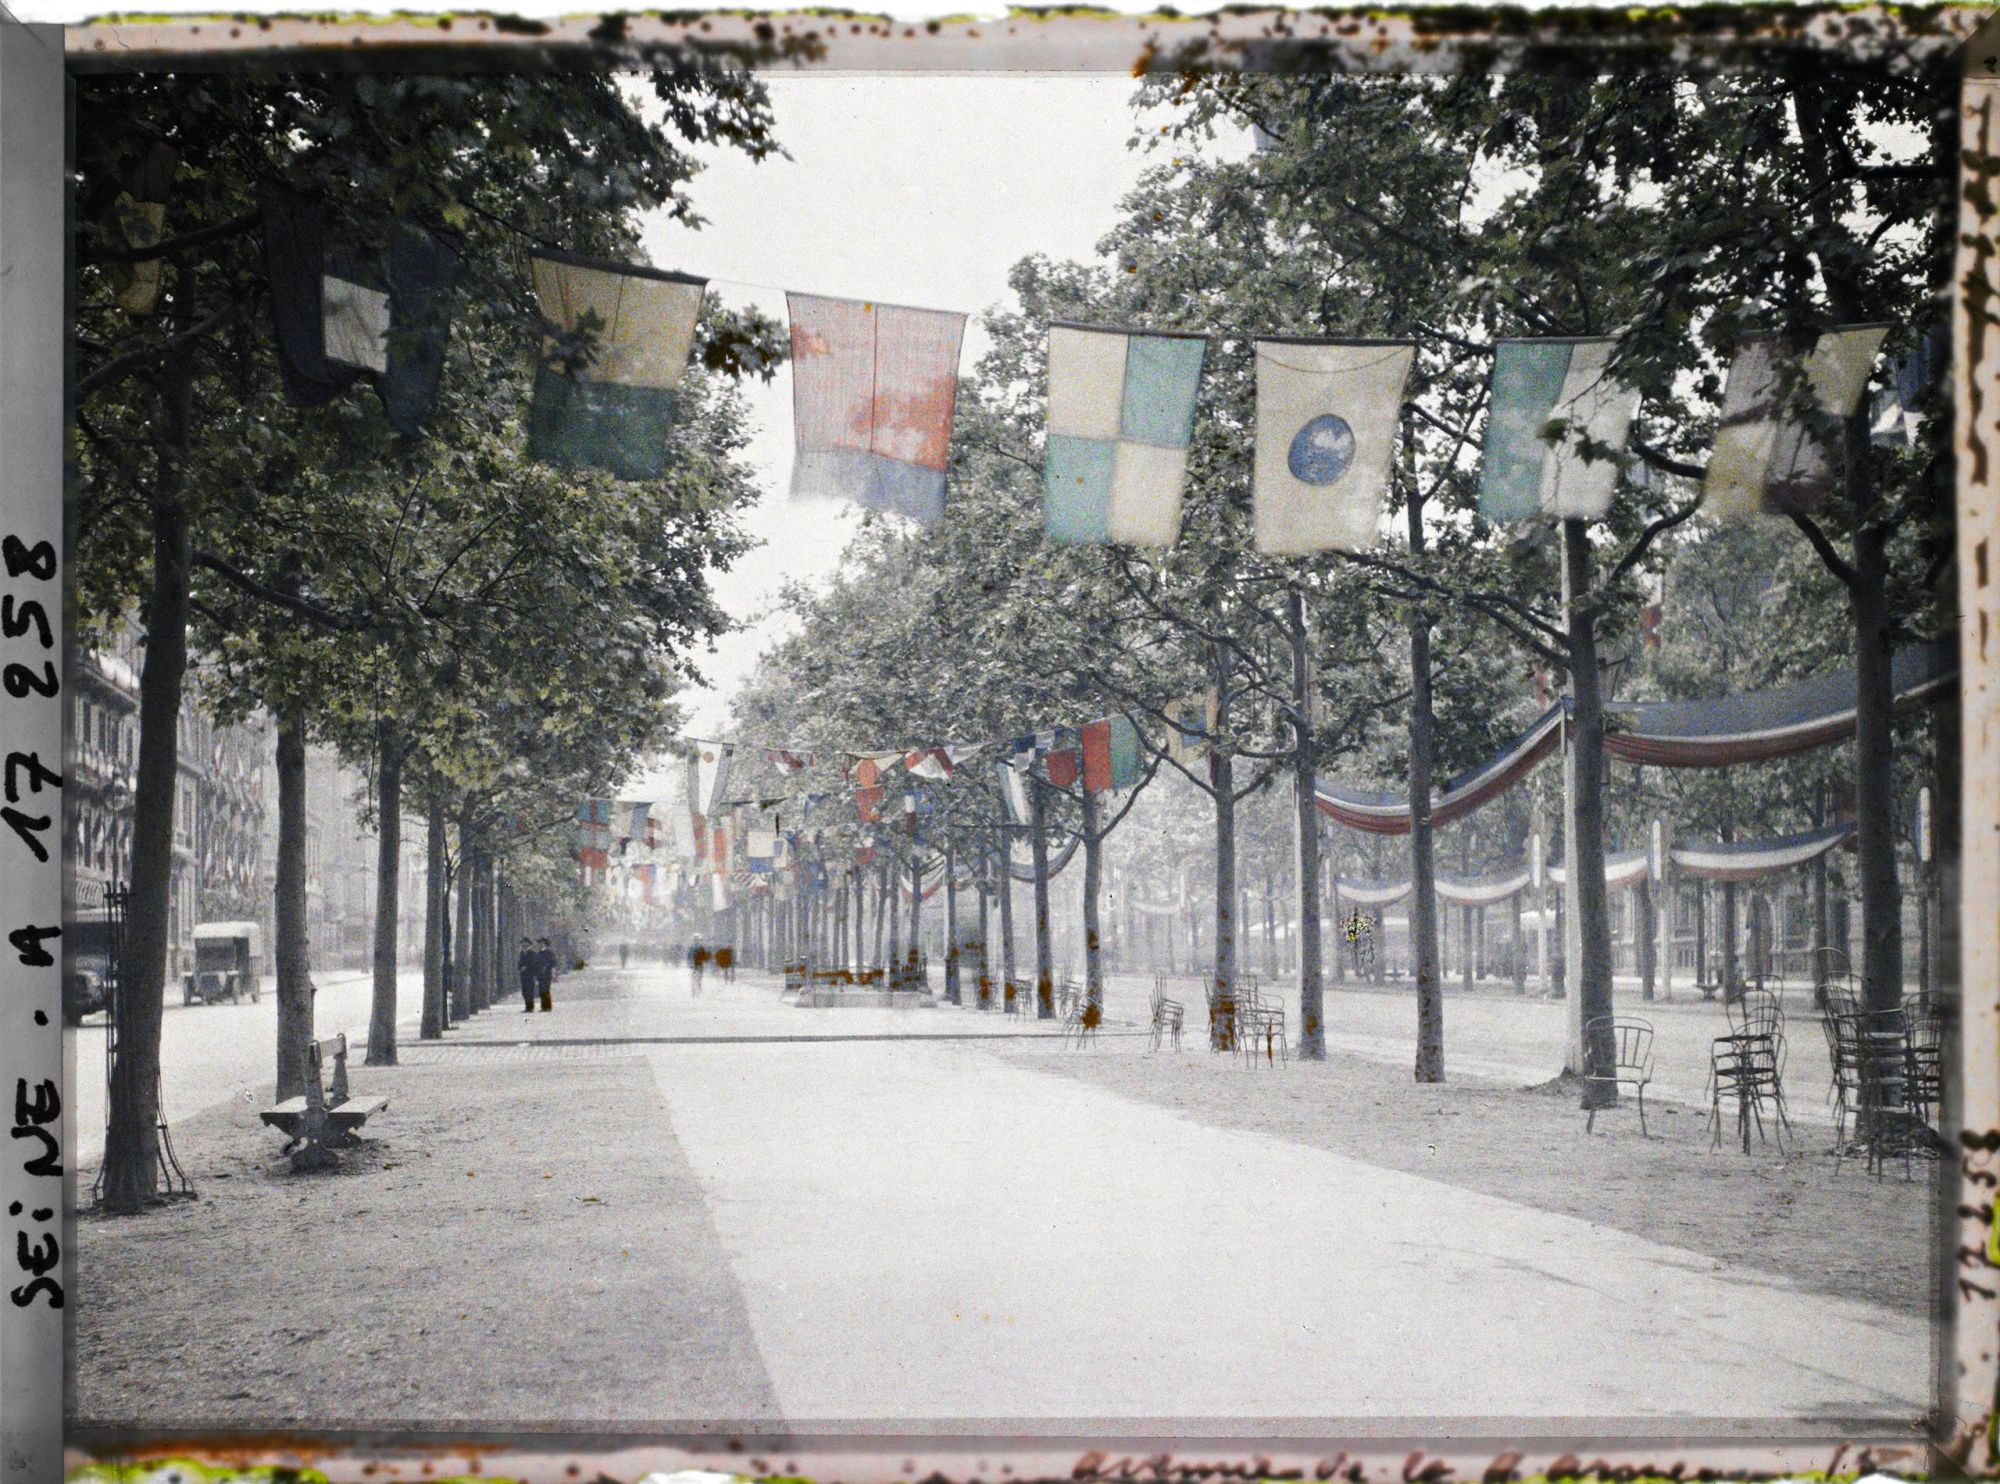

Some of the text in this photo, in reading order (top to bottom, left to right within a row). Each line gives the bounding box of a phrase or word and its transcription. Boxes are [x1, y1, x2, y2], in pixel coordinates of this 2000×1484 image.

[1, 534, 59, 699] 258
[0, 751, 62, 863] 17
[8, 924, 62, 968] A
